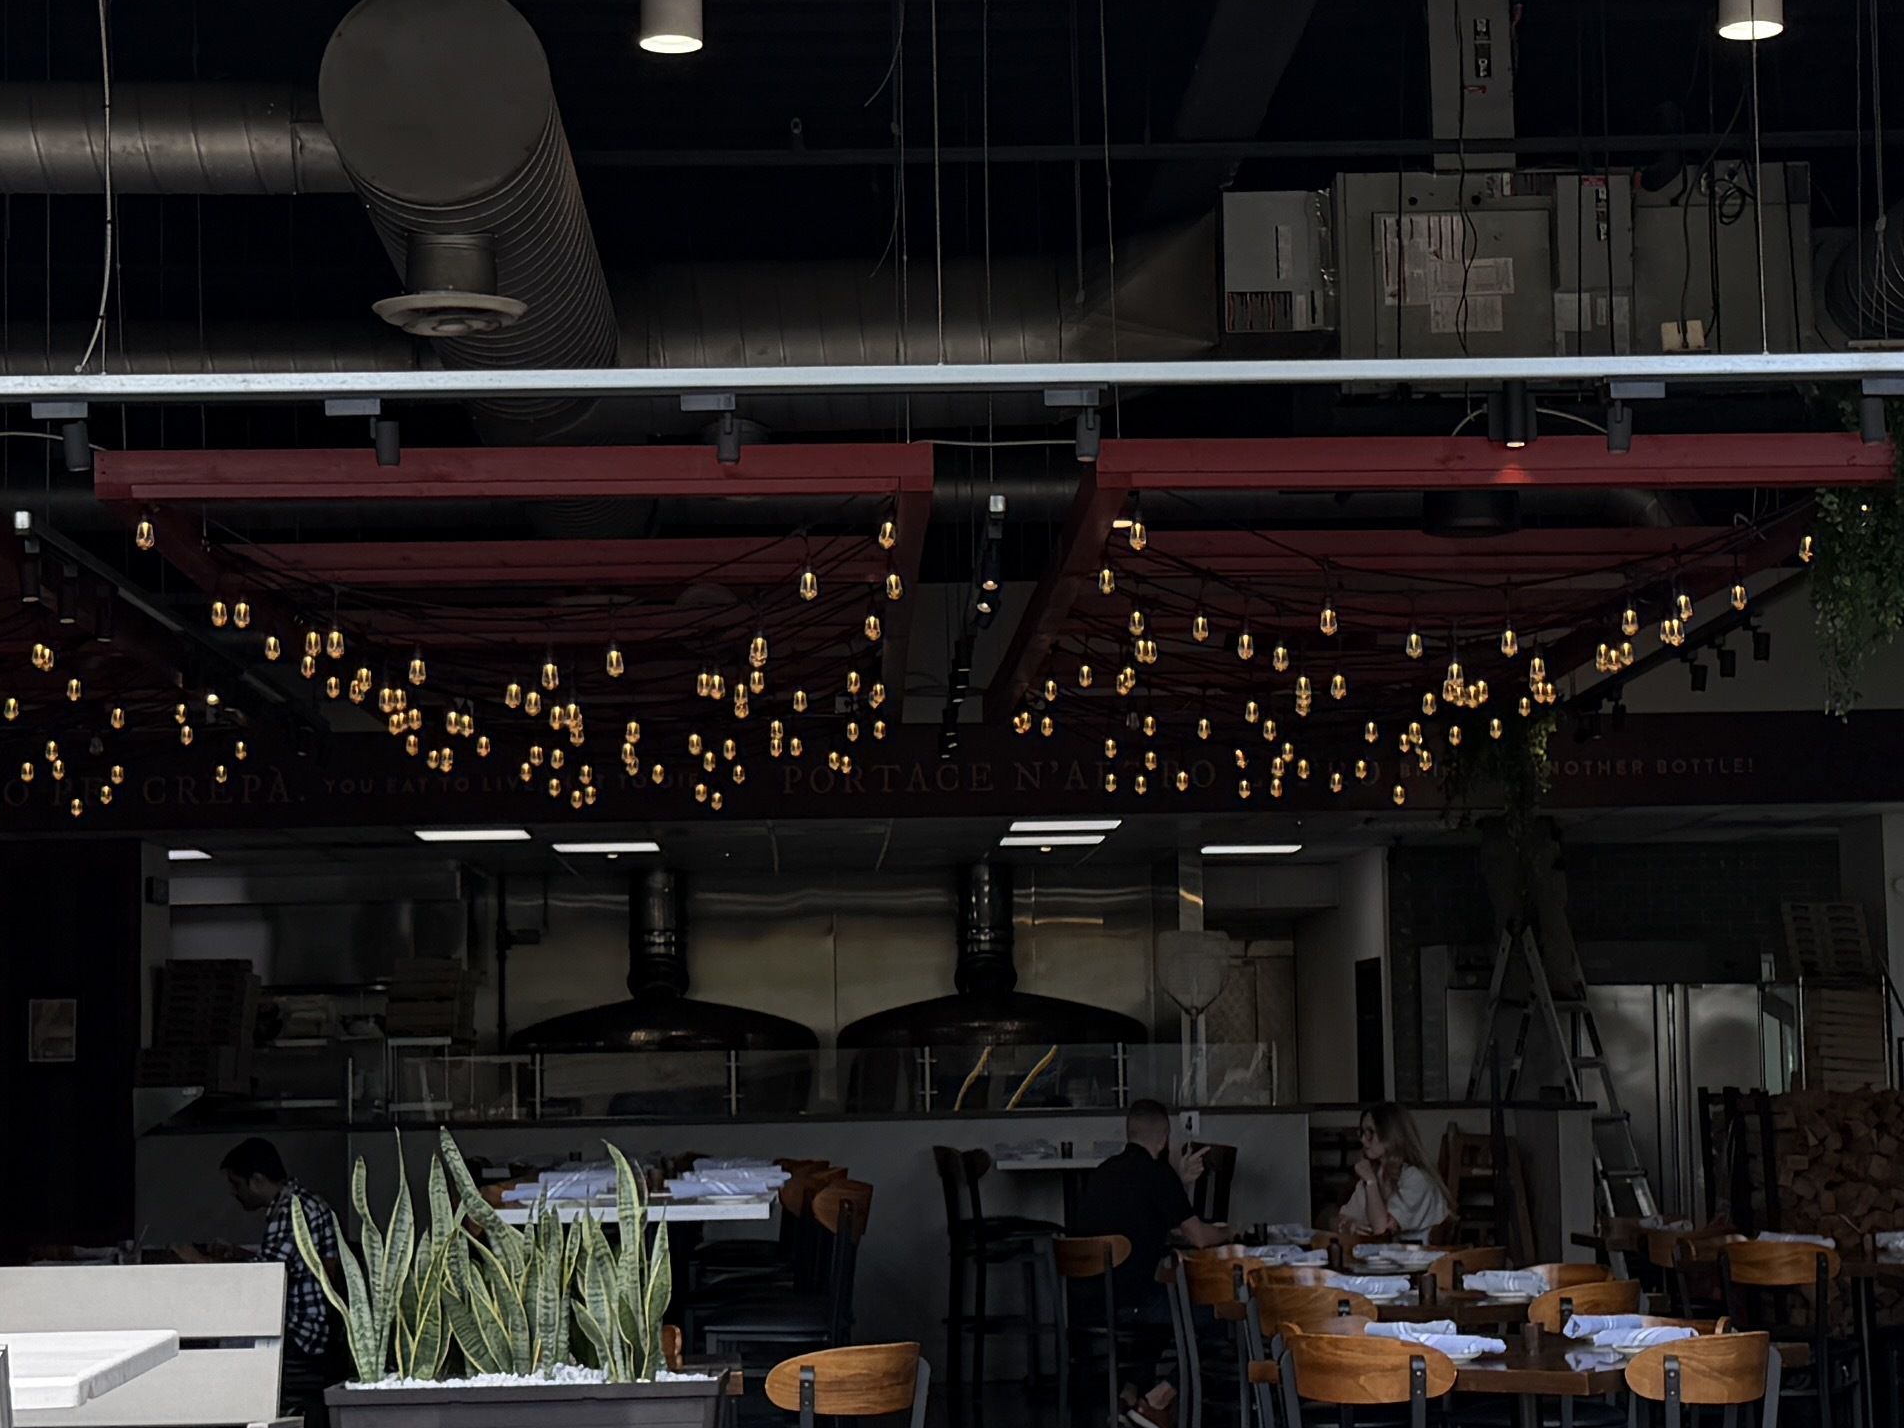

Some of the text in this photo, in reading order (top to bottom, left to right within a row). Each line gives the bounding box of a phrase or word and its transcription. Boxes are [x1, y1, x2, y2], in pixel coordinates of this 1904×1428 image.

[1655, 756, 1756, 775] BOTTLE!
[142, 764, 307, 807] CREPÀ.
[323, 778, 376, 795] YOU
[386, 776, 430, 794] EAT
[438, 776, 471, 793] TO
[781, 762, 996, 796] PORTACE
